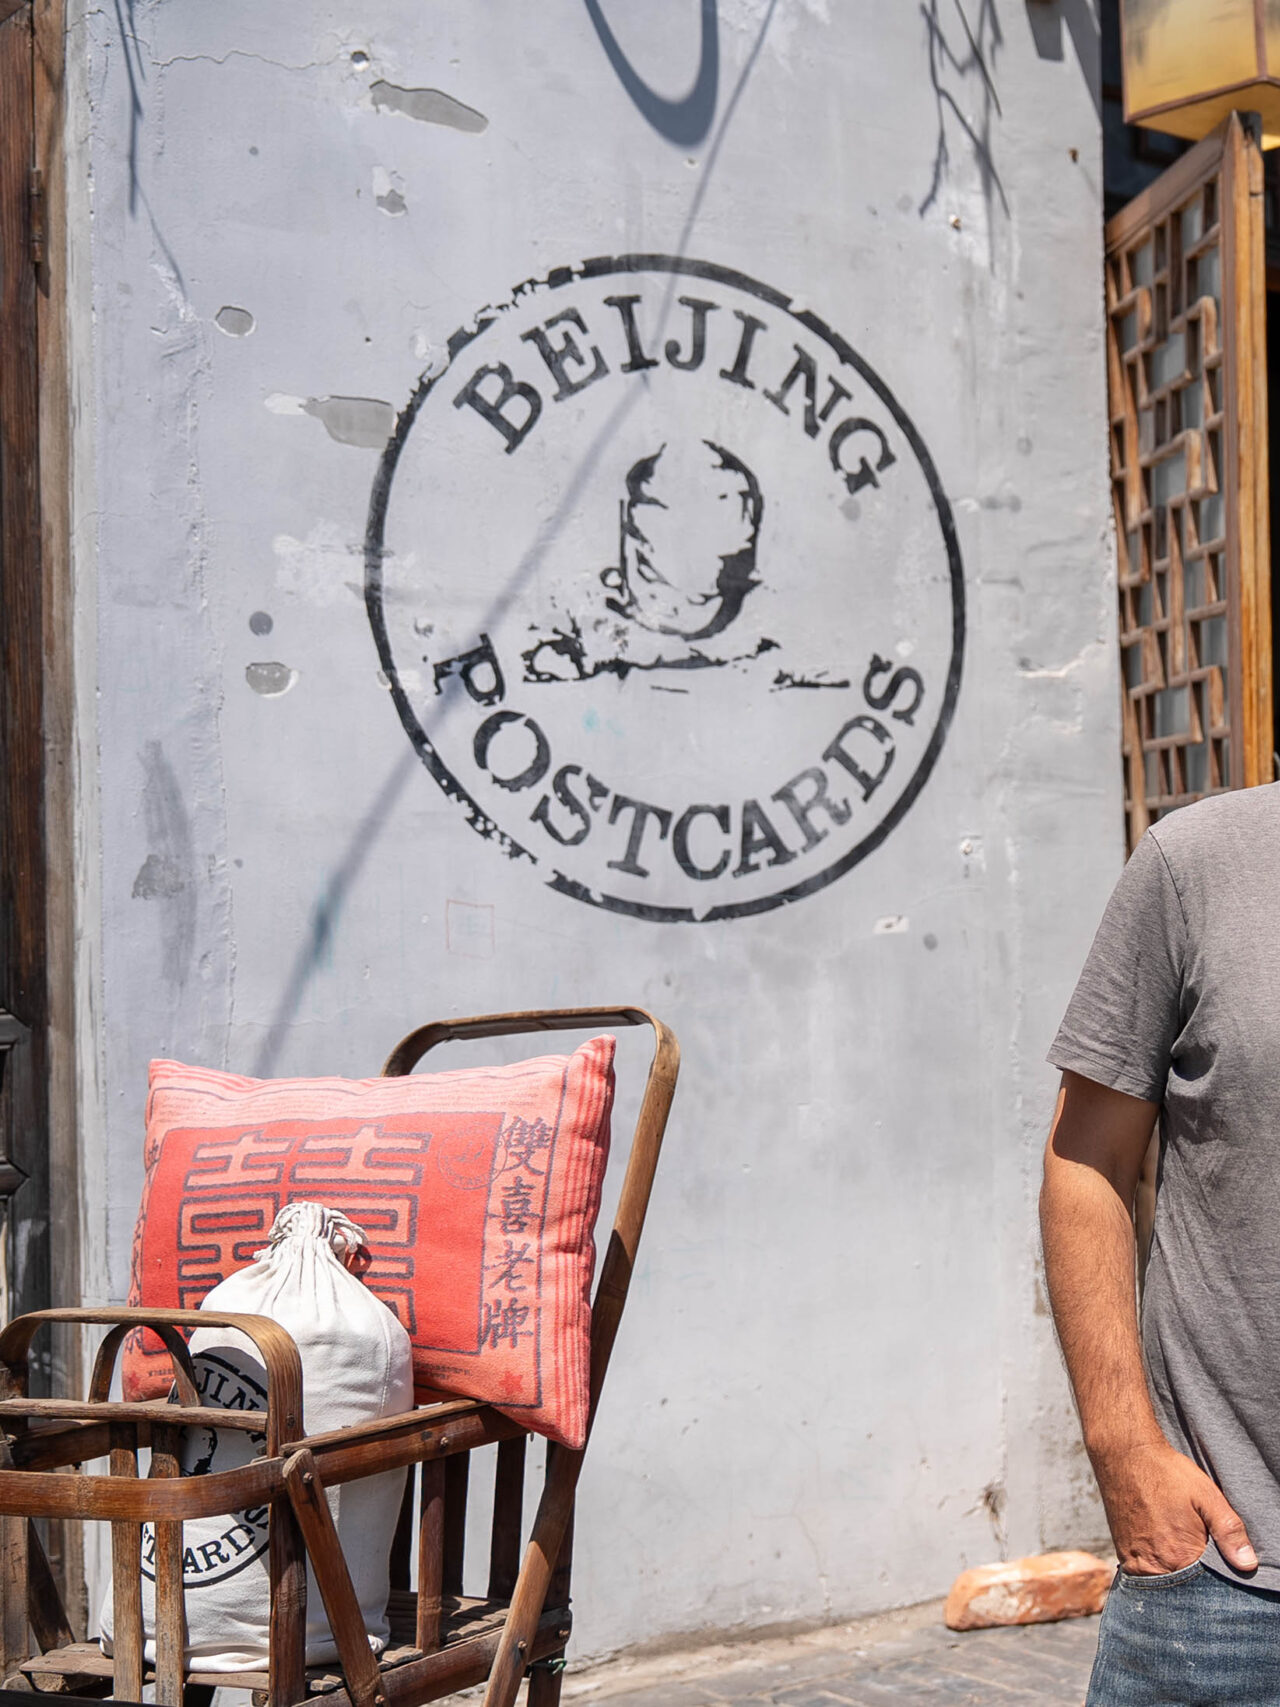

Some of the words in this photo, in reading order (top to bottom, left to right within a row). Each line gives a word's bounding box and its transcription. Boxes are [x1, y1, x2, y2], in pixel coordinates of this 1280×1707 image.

[453, 295, 896, 494] BEIJING
[433, 633, 925, 880] POSTCARDS
[478, 1116, 552, 1348] 雙喜老牌
